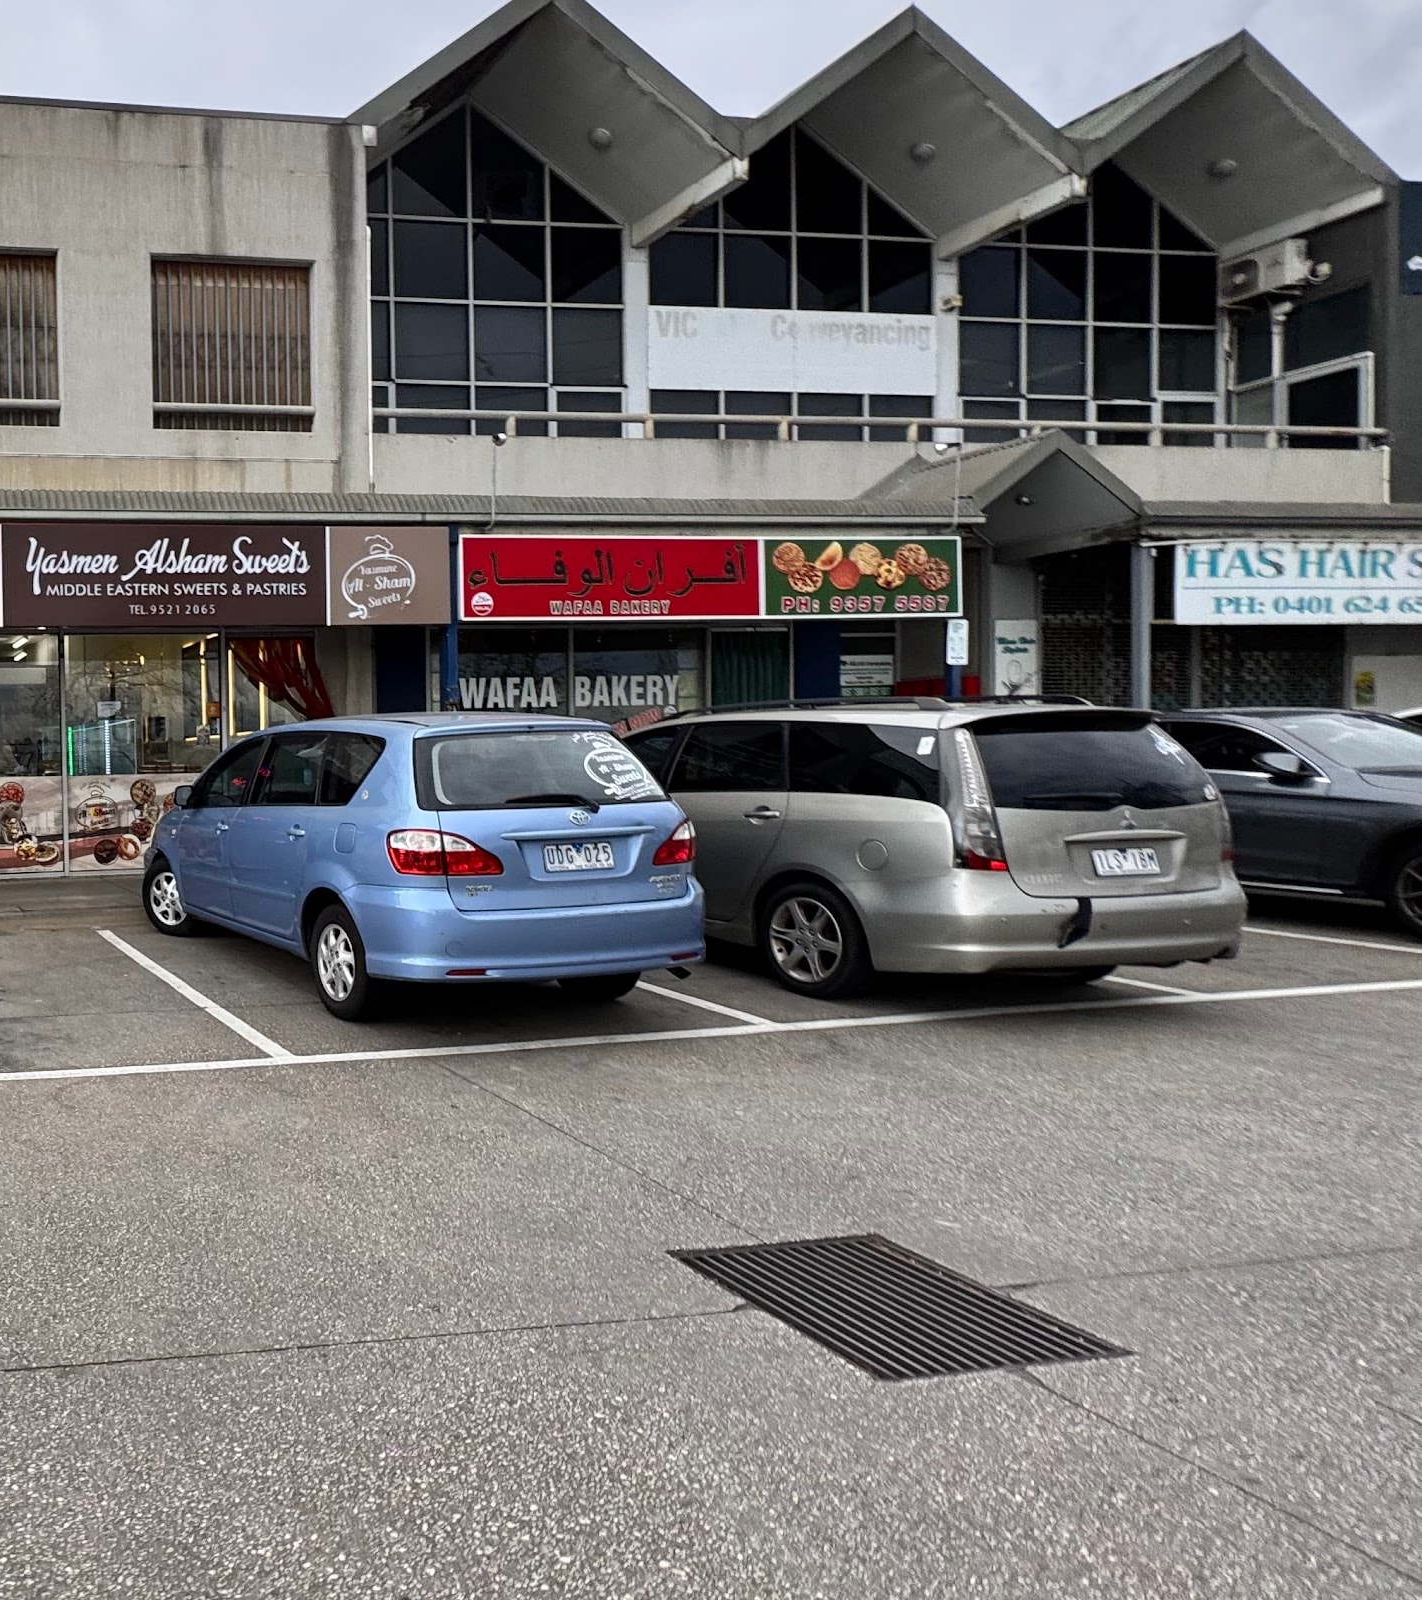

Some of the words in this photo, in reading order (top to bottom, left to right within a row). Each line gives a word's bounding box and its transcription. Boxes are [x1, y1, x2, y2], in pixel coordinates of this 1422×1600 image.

[655, 310, 698, 338] VIC
[25, 536, 119, 595] Yasmen
[120, 538, 228, 582] Alsham
[232, 536, 311, 575] Sweets
[1185, 546, 1286, 579] HAS
[1298, 547, 1397, 581] HAIR
[46, 583, 105, 596] MIDDLE
[107, 583, 169, 596] EASTERN
[174, 583, 228, 596] SWEETS
[231, 583, 243, 596] &
[246, 583, 307, 597] PASTRIES
[373, 575, 412, 591] Sham
[185, 604, 216, 615] 2065
[549, 600, 604, 615] WAFAA
[609, 599, 672, 615] BAKERY
[780, 595, 821, 613] PH:
[829, 595, 886, 613] 9357
[894, 594, 950, 613] 5587
[1213, 595, 1266, 615] PH:
[1272, 595, 1334, 615] 0401
[1342, 595, 1390, 615] 624
[458, 676, 559, 710] WAFAA
[574, 674, 681, 708] BAKERY
[546, 846, 574, 865] UDG
[583, 843, 612, 863] 025
